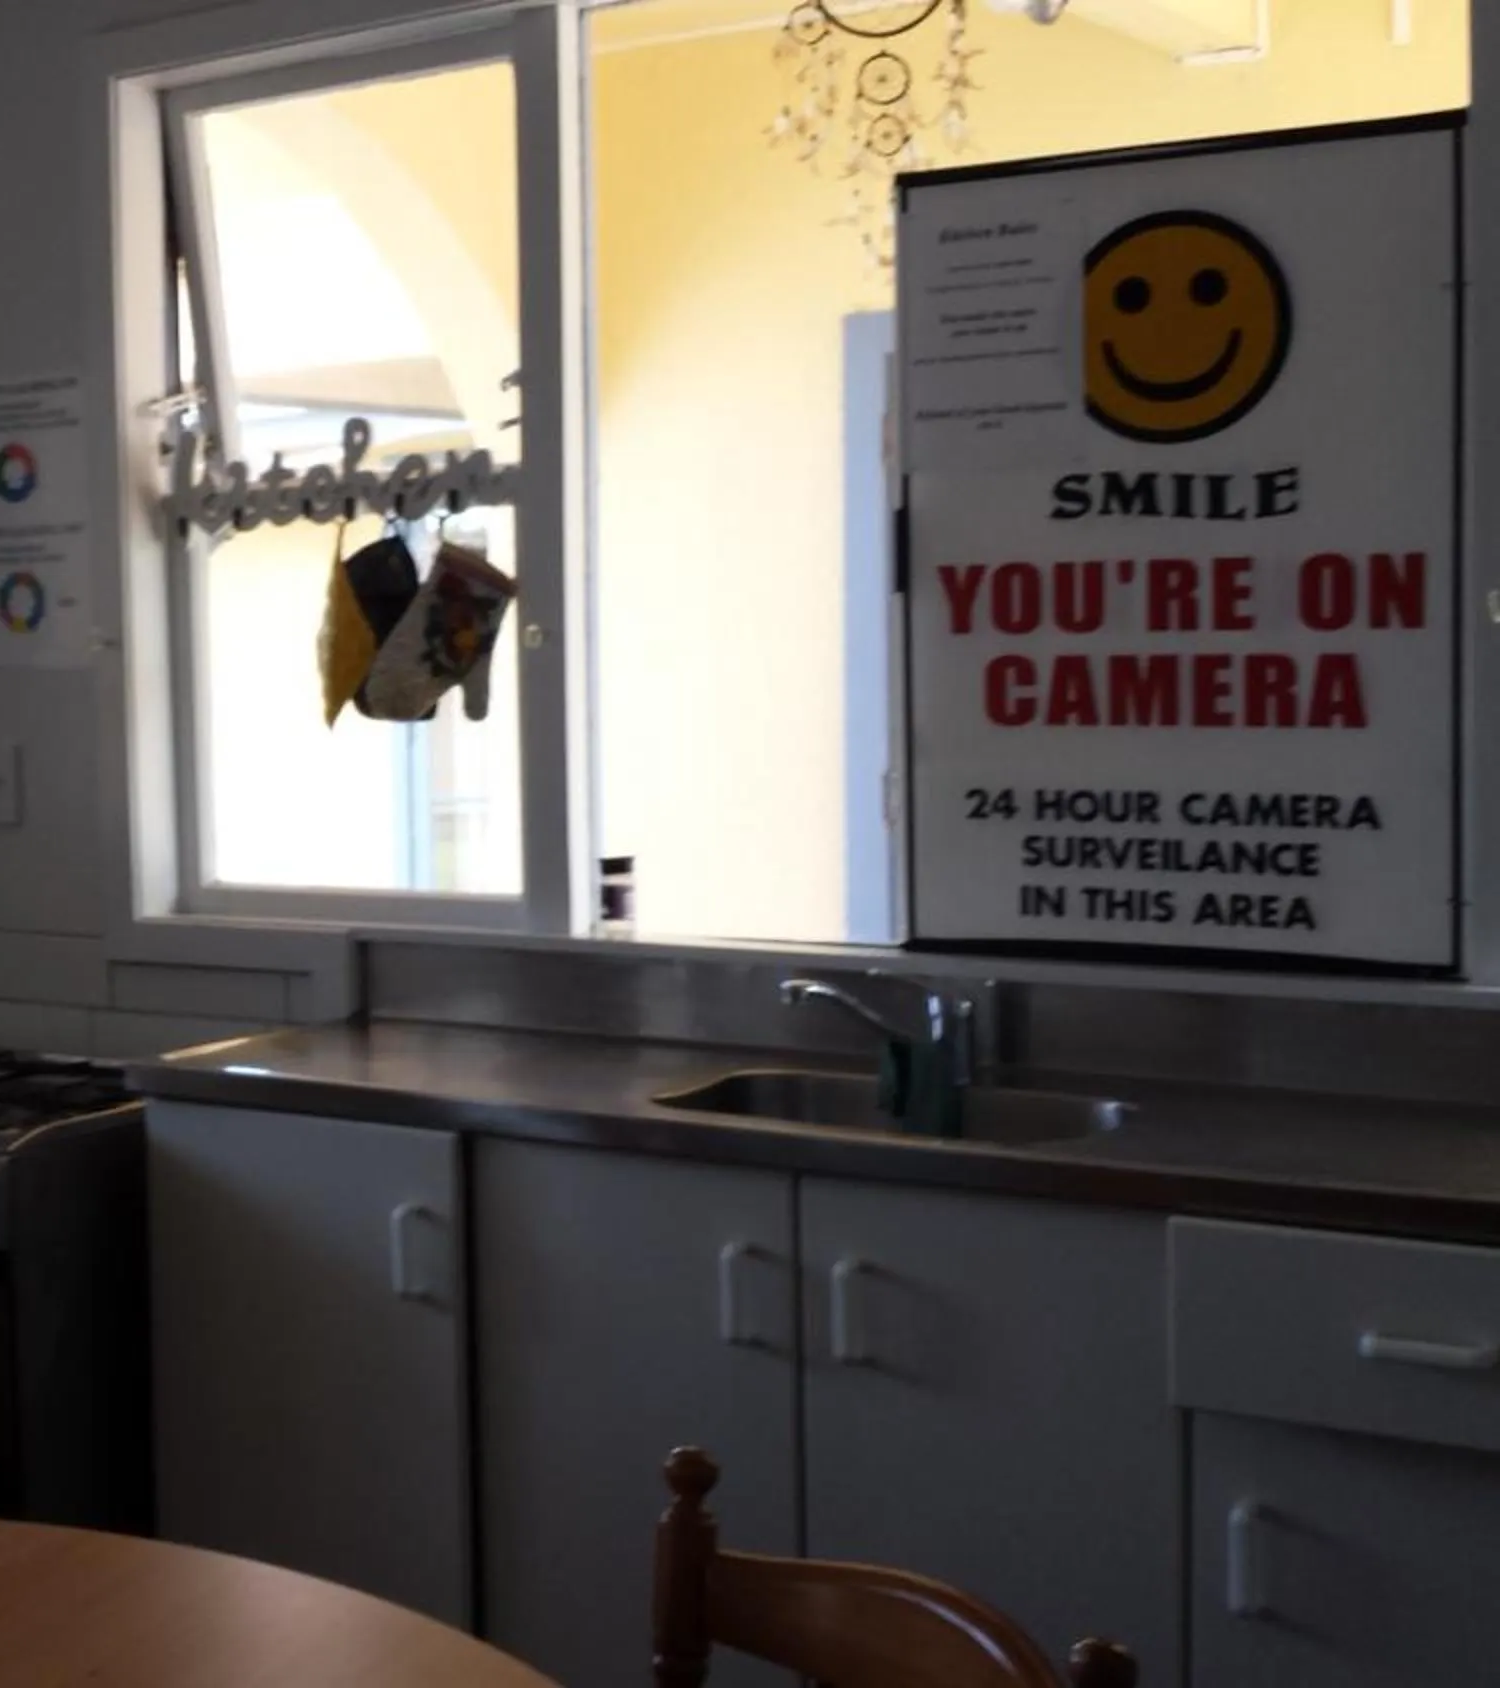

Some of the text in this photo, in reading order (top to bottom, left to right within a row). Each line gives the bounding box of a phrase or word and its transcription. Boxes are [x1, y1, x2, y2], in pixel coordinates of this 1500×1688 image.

[1049, 466, 1301, 522] SMILE
[937, 550, 1428, 636] YOU'RE ON
[983, 652, 1370, 730] CAMERA
[965, 788, 1383, 831] 24 HOUR CAMERA
[1022, 834, 1322, 878] SURVEILANCE
[1020, 885, 1318, 932] IN THIS AREA
